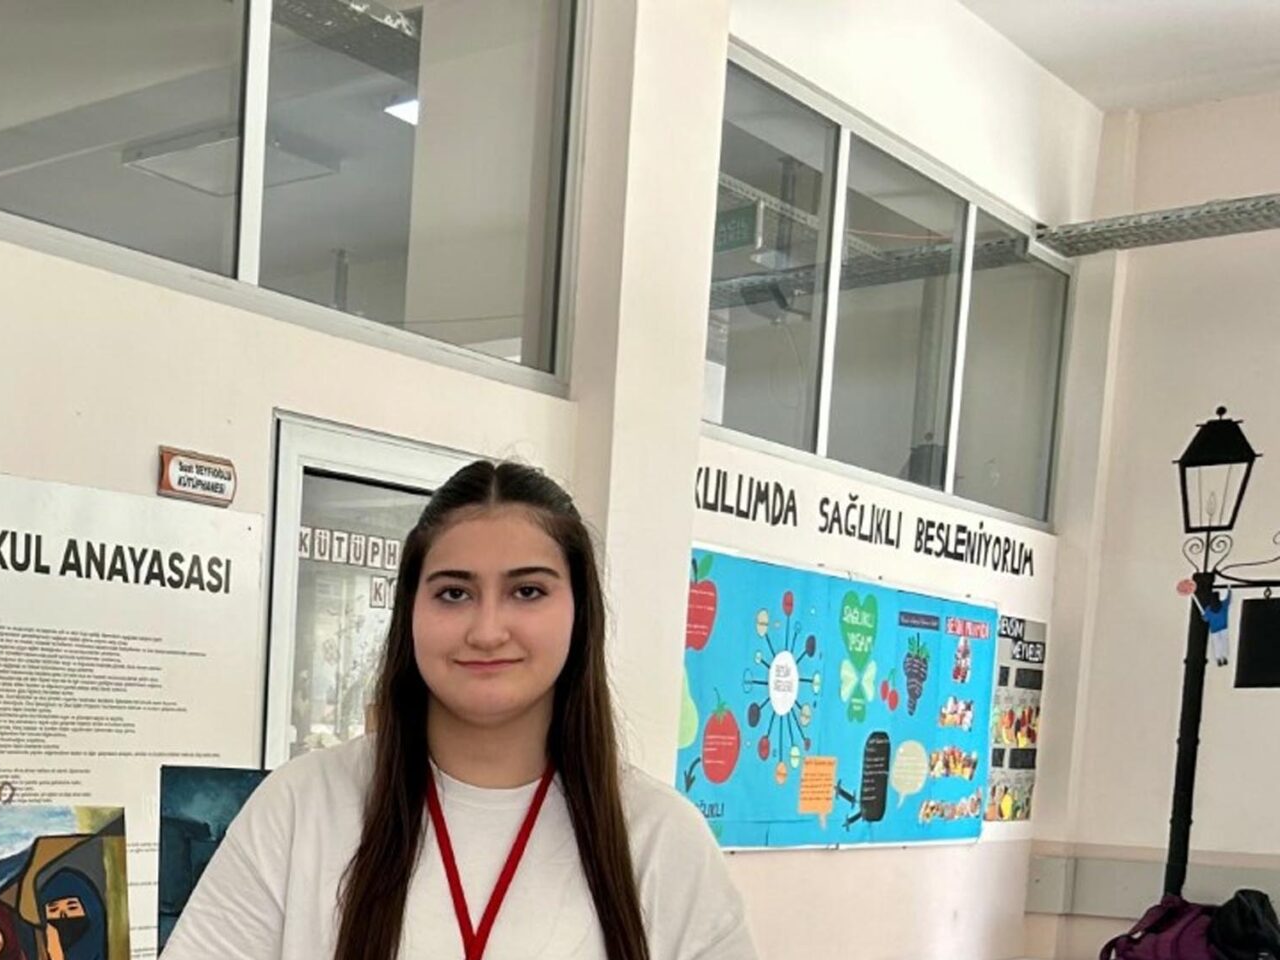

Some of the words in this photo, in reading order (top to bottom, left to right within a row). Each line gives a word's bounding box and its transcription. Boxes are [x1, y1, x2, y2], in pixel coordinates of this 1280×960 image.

[59, 537, 231, 595] ANAYASASI
[818, 492, 902, 549] SAĞLIKLI
[914, 517, 1034, 577] BESLENİYORUM
